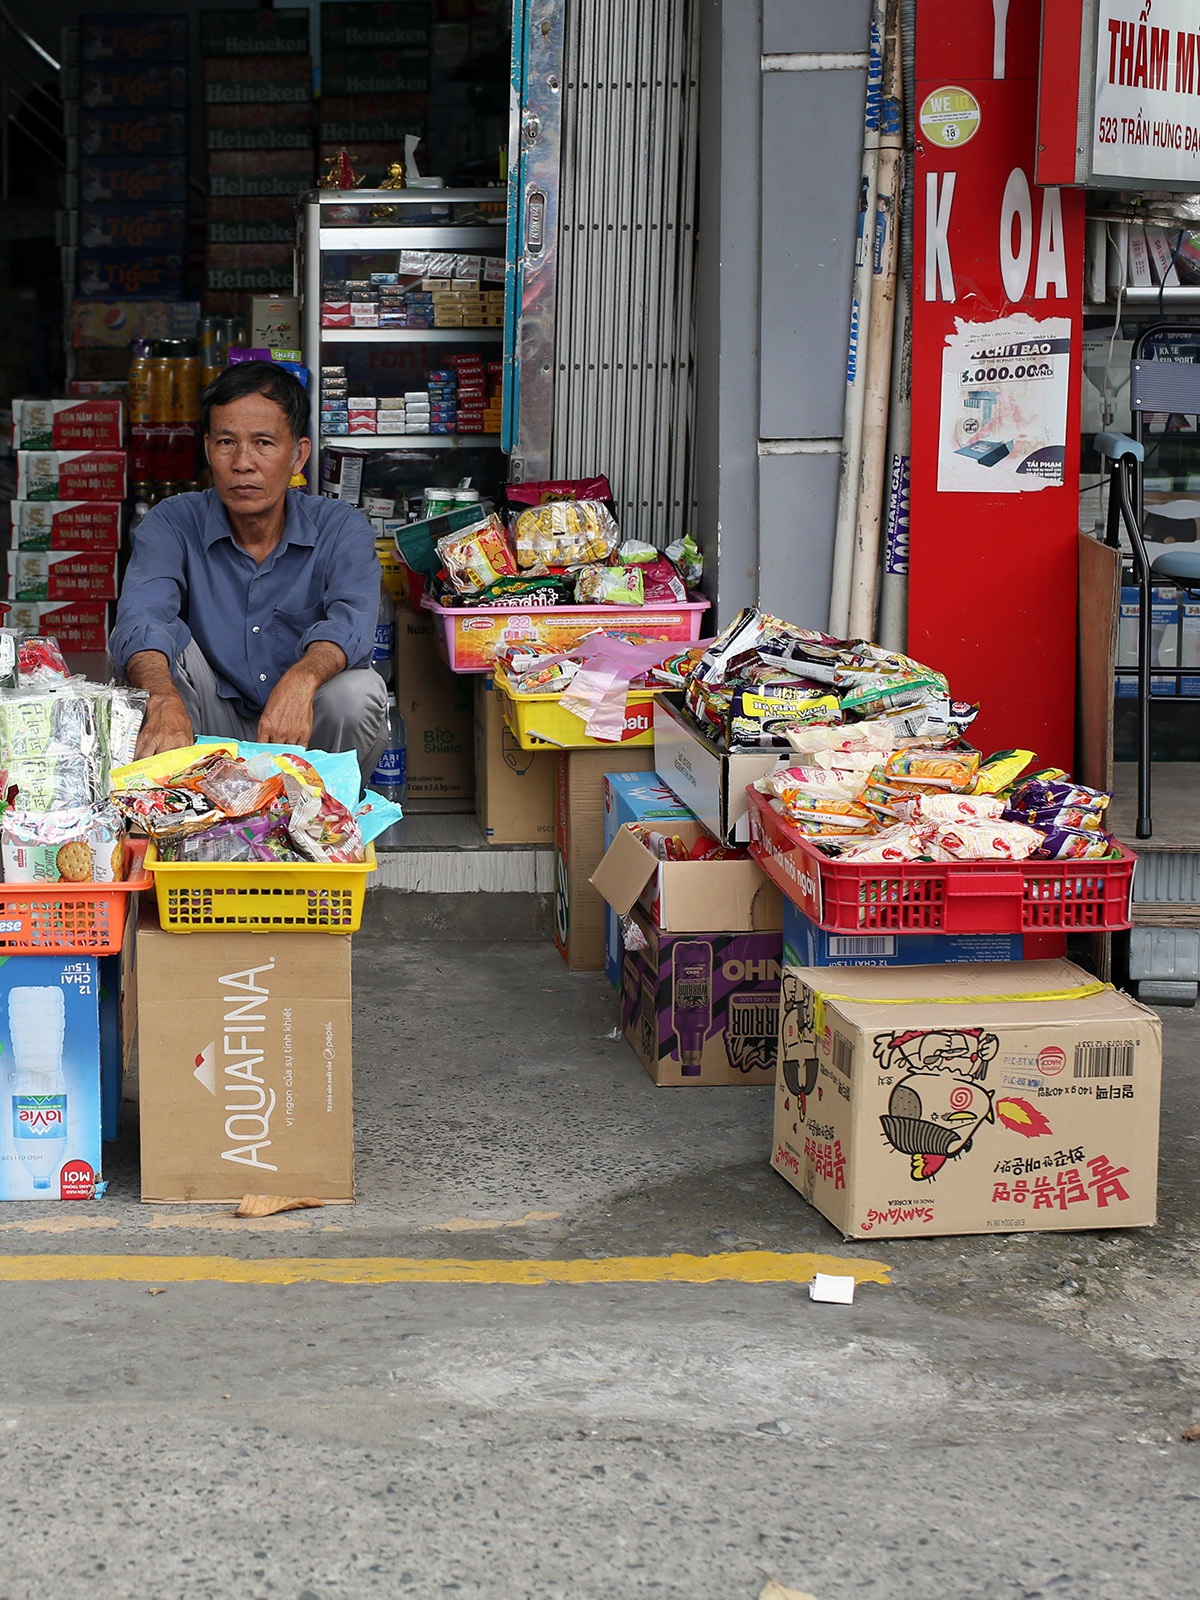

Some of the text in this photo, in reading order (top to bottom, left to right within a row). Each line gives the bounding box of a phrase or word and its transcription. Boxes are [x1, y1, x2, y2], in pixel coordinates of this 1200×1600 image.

[1108, 0, 1169, 91] THẨM
[930, 95, 968, 112] WE ID
[1099, 108, 1182, 149] 523 TRẦN HƯNG
[925, 171, 957, 302] K
[1021, 343, 1051, 355] BAO
[508, 616, 530, 628] 22
[424, 743, 461, 754] Shield
[797, 871, 816, 903] ngày
[61, 975, 91, 985] CHAI
[79, 985, 91, 995] 12
[678, 984, 708, 996] WARRIOR
[217, 963, 278, 1171] AQUAFINA
[282, 1007, 295, 1127] vị ngon của sự tinh khiết
[1039, 1057, 1062, 1067] HACCP
[876, 1074, 895, 1087] 호치
[1038, 1086, 1063, 1099] 40개입
[1077, 1086, 1093, 1095] 140
[1095, 1084, 1134, 1101] 멀티팩
[19, 1110, 62, 1127] laVie
[803, 1136, 847, 1191] 불닭볶음면
[993, 1144, 1086, 1174] 화끈한 매운맛!
[64, 1170, 91, 1182] MỚI
[991, 1153, 1130, 1212] 불닭볶음면
[865, 1205, 935, 1225] SAMYANG
